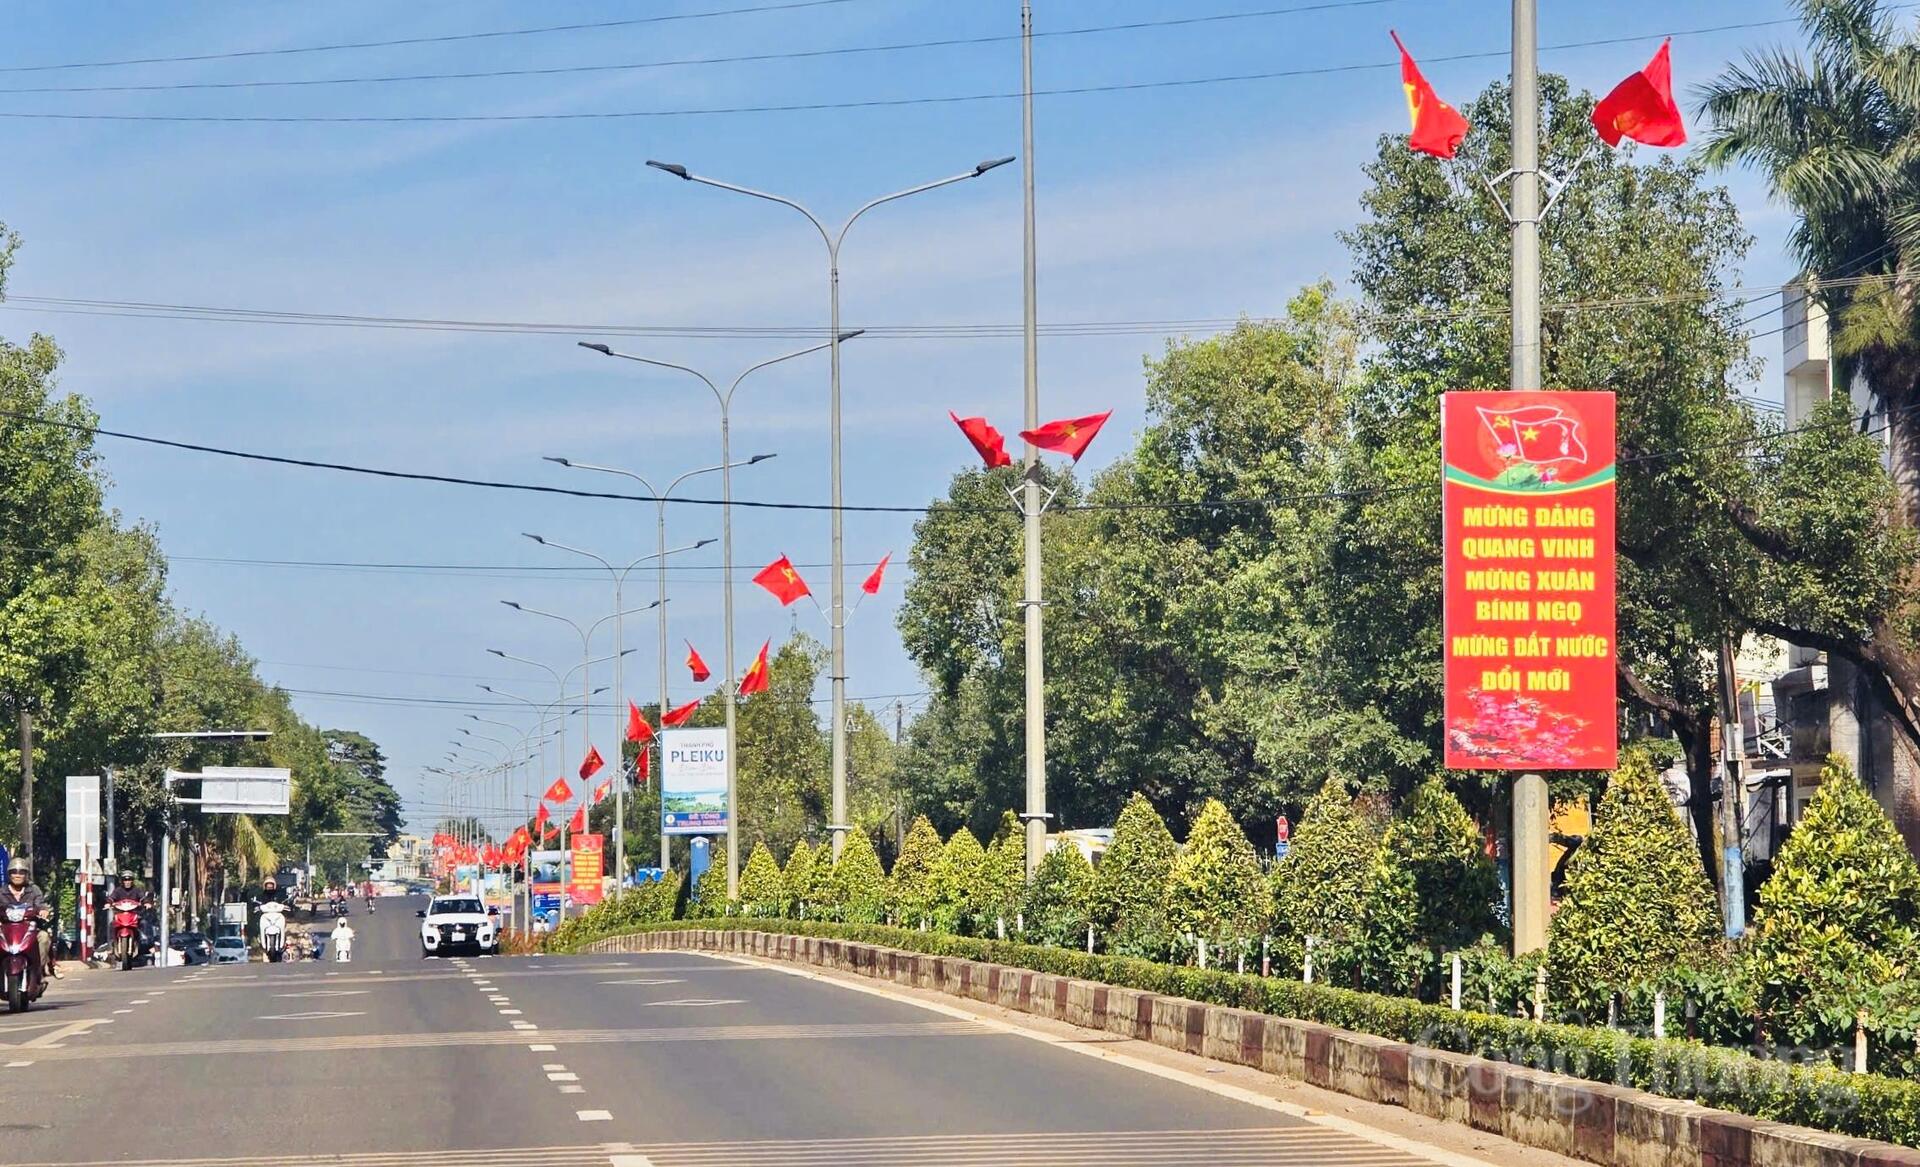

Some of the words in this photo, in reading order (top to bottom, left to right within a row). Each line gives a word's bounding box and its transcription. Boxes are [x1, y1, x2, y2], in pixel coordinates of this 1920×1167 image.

[1463, 504, 1529, 528] MỪNG
[1534, 503, 1595, 528] ĐẢNG
[1462, 538, 1536, 560] QUANG
[1541, 538, 1595, 559] VINH
[1465, 568, 1531, 592] MỪNG
[1536, 568, 1595, 592] XUÂN
[1475, 598, 1530, 621] BÍNH
[1536, 600, 1582, 626] NGỌ
[1452, 633, 1509, 657] MỪNG
[1514, 630, 1552, 657] ĐẤT
[1556, 634, 1609, 657] NƯỚC
[1481, 664, 1521, 691] ĐỔI
[1527, 668, 1570, 692] MỚI
[671, 750, 724, 763] PLEIKU
